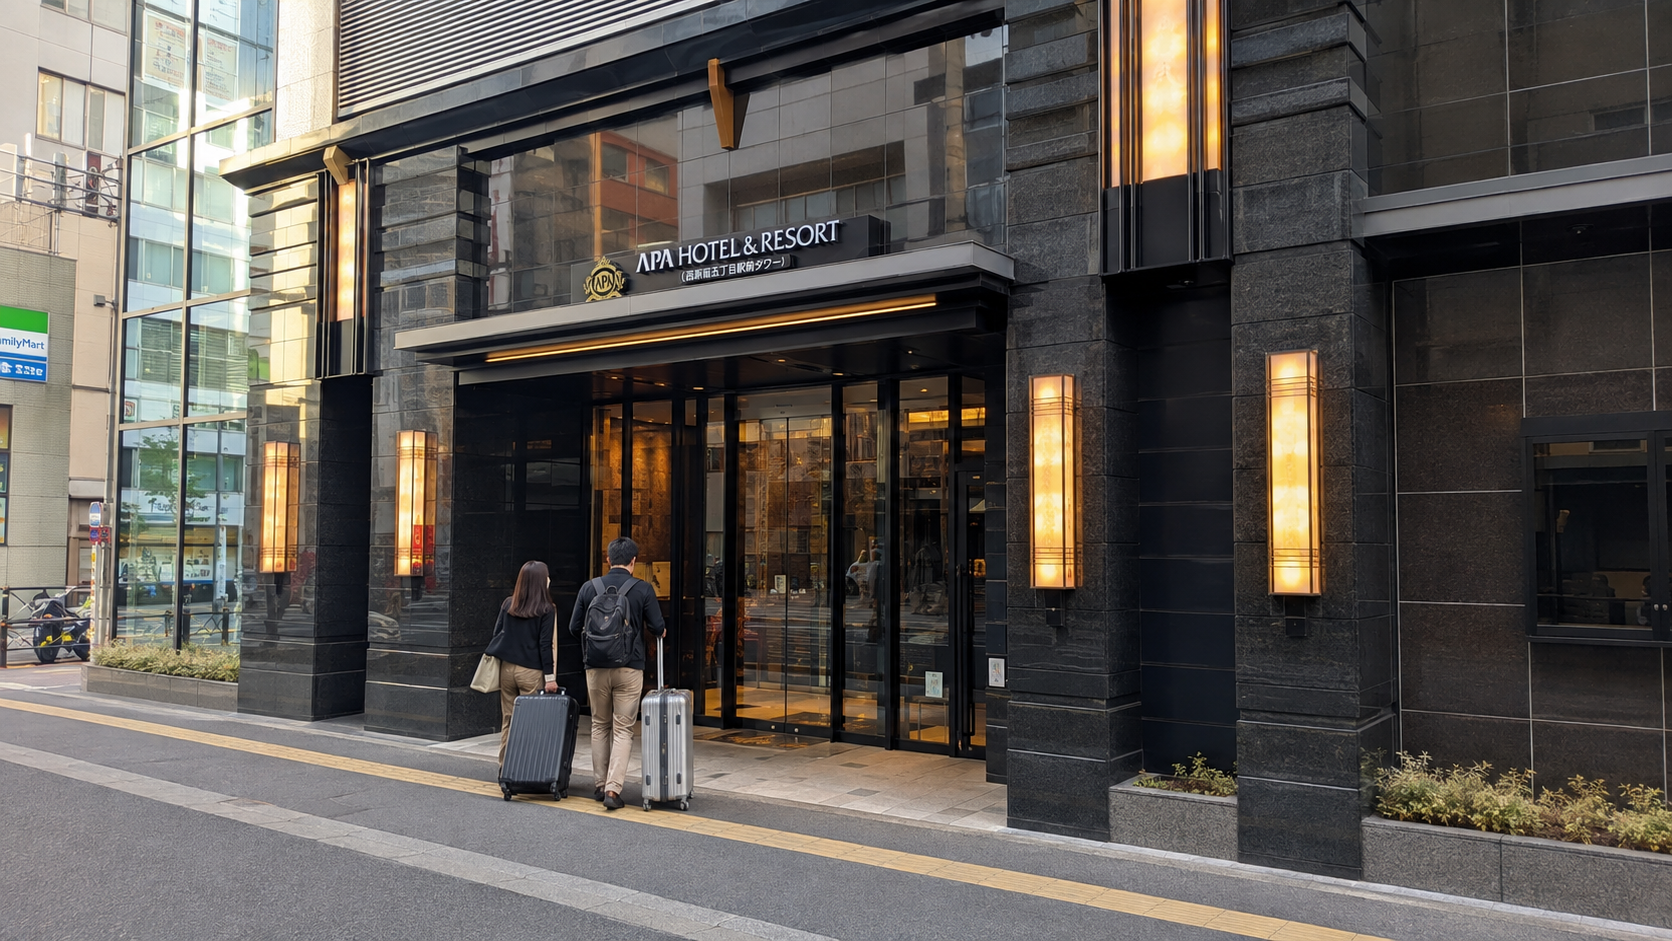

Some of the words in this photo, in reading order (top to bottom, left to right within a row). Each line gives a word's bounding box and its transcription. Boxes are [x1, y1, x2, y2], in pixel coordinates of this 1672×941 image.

[635, 248, 675, 273] APA
[678, 237, 740, 267] HOTEL
[744, 235, 759, 256] &
[761, 219, 840, 253] RESORT
[595, 274, 614, 291] APA
